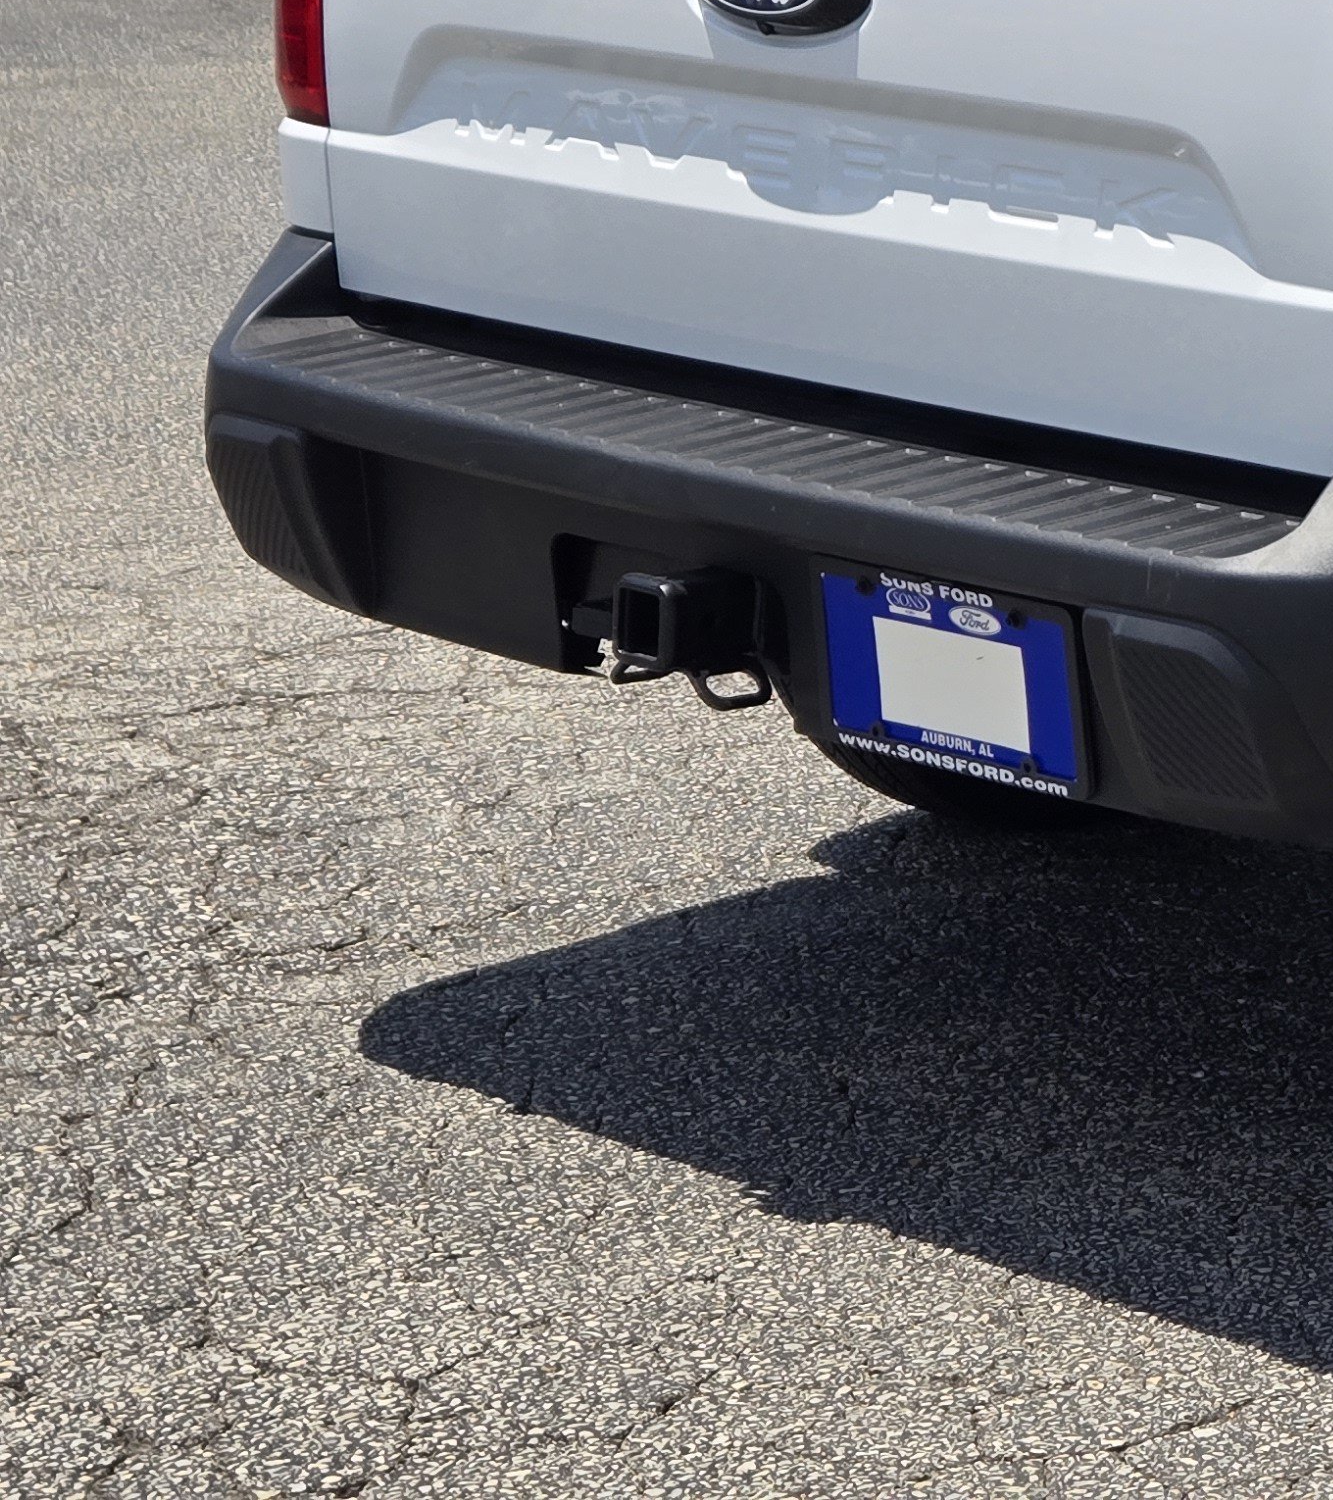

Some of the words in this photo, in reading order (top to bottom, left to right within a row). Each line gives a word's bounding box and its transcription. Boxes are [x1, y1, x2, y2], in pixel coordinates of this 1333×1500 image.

[879, 572, 934, 596] SONS
[938, 585, 993, 608] FORD
[892, 591, 925, 610] SONS
[959, 609, 990, 631] Ford
[921, 730, 975, 755] AUBURN,
[979, 744, 994, 758] AL
[838, 732, 1068, 797] www.SONSFORD.com
